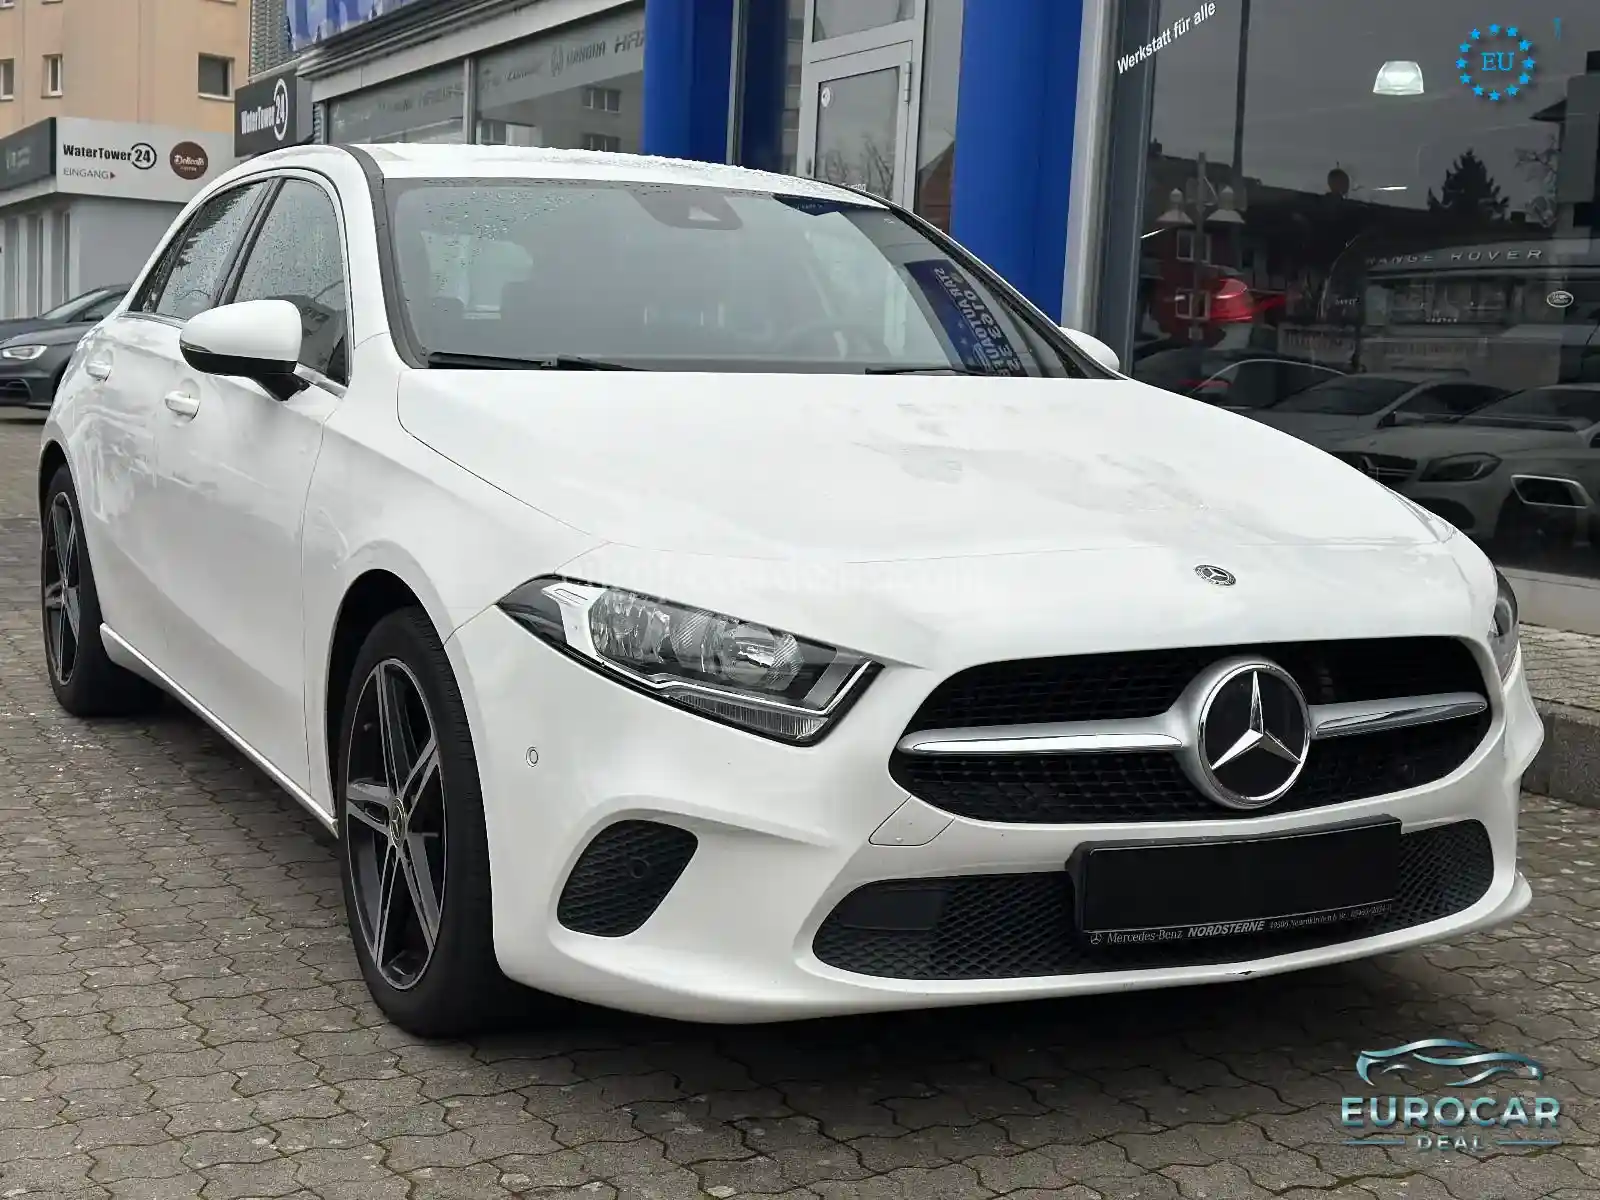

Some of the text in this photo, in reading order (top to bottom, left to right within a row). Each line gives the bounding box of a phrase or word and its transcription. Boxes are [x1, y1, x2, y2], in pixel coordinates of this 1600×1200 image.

[1117, 2, 1216, 74] Werkstatt für alle
[134, 149, 151, 163] 24
[63, 167, 109, 180] EINGANG
[1451, 249, 1542, 262] ROVER
[1107, 930, 1183, 944] Mercedes-Benz
[1187, 920, 1266, 938] NORDSTERNE
